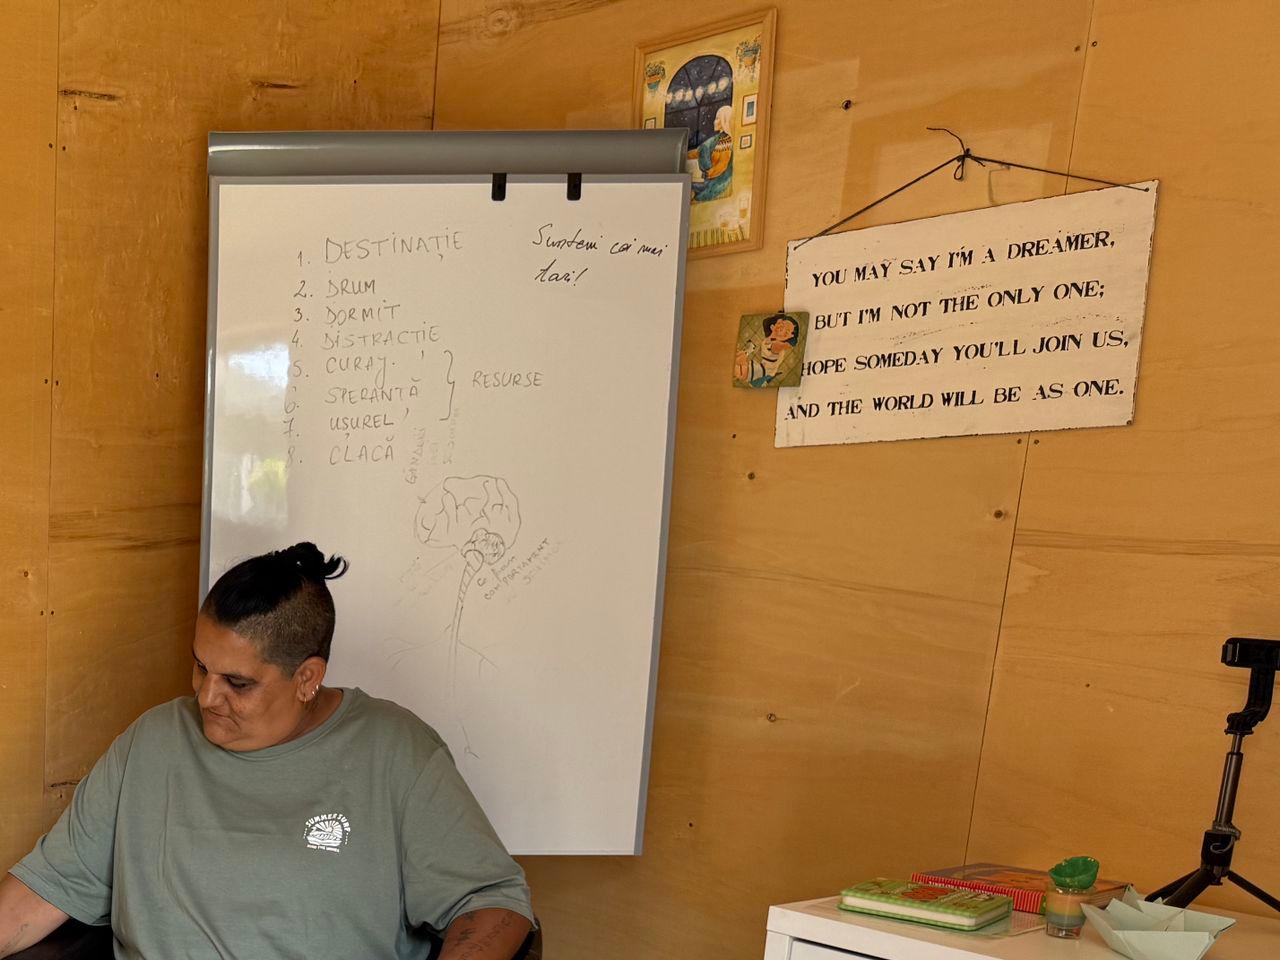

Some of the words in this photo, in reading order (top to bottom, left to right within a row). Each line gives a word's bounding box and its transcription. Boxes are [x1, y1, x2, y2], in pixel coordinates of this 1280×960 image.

[812, 268, 847, 288] YOU
[854, 261, 892, 282] MAY
[899, 254, 940, 275] SAY
[948, 248, 974, 268] I'M
[981, 247, 996, 264] A
[1007, 230, 1115, 260] DREAMER,
[293, 279, 313, 298] 2.
[326, 278, 375, 298] DRUM
[814, 312, 851, 330] BUT
[858, 307, 881, 325] I'M
[890, 301, 931, 321] NOT
[939, 294, 980, 314] THE
[987, 285, 1045, 308] ONLY
[1053, 280, 1105, 299] ONE;
[293, 307, 309, 322] 3.
[325, 300, 400, 326] DORMIT
[801, 357, 847, 377] HOPE
[854, 347, 943, 371] SOMEDAY
[953, 339, 1027, 361] YOU'LL
[1032, 333, 1083, 354] JOIN
[1092, 329, 1129, 348] US,
[472, 370, 544, 390] RESURSE
[784, 402, 820, 421] AND
[827, 398, 863, 416] THE
[872, 393, 934, 412] WORLD
[941, 390, 984, 407] WILL
[994, 386, 1022, 404] BE
[1032, 382, 1064, 400] AS
[1073, 378, 1124, 398] ONE.
